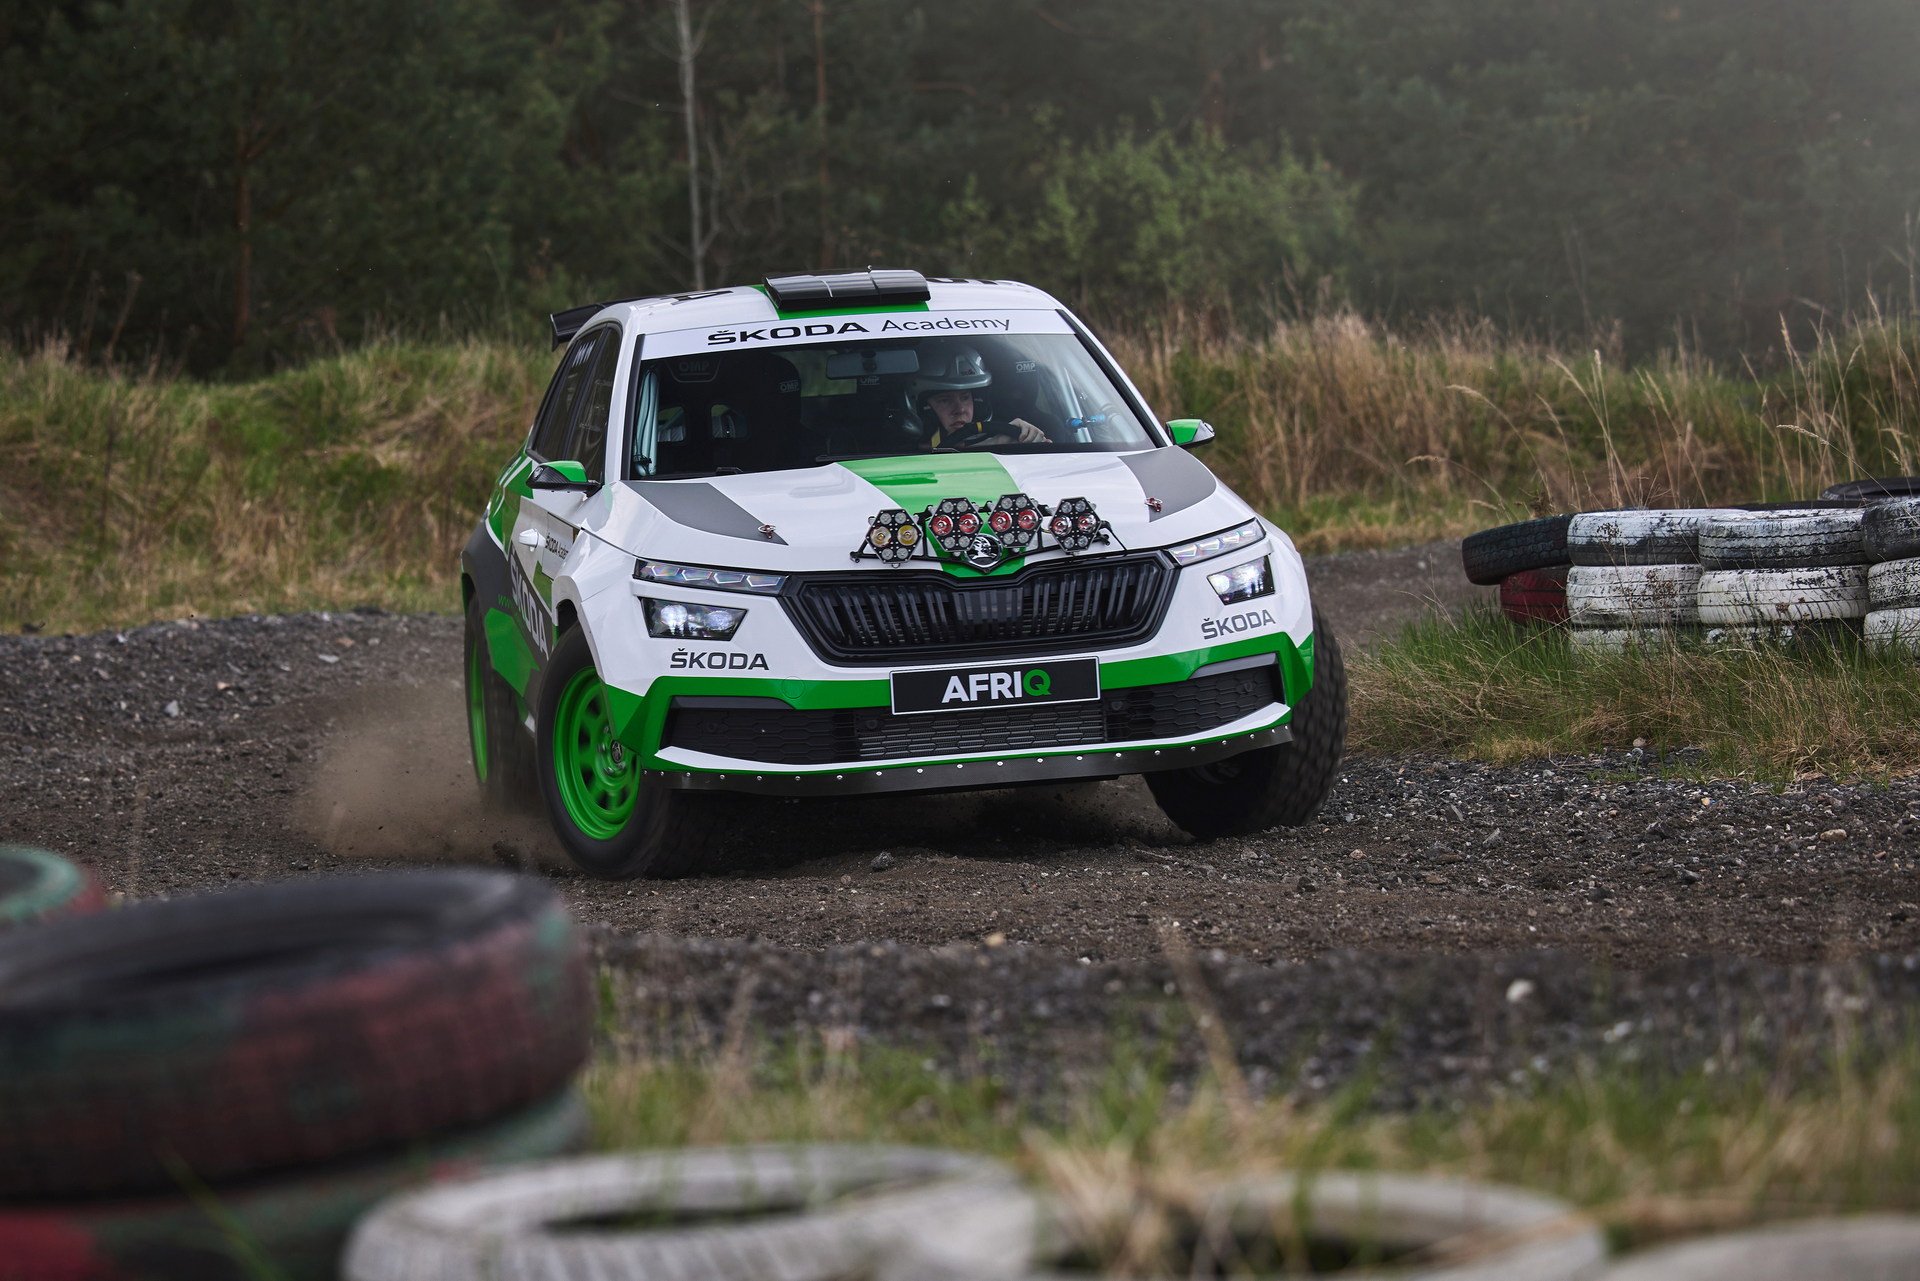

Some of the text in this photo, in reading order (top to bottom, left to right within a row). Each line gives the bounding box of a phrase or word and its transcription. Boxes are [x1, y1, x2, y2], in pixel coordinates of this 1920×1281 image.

[708, 314, 1011, 346] ŠKODA Academy
[679, 361, 710, 373] OMP
[1016, 362, 1036, 372] OMP
[511, 545, 549, 661] ŠKODA
[1201, 609, 1276, 640] ŠKODA
[670, 647, 769, 670] ŠKODA
[942, 669, 1051, 704] AFRIQ
